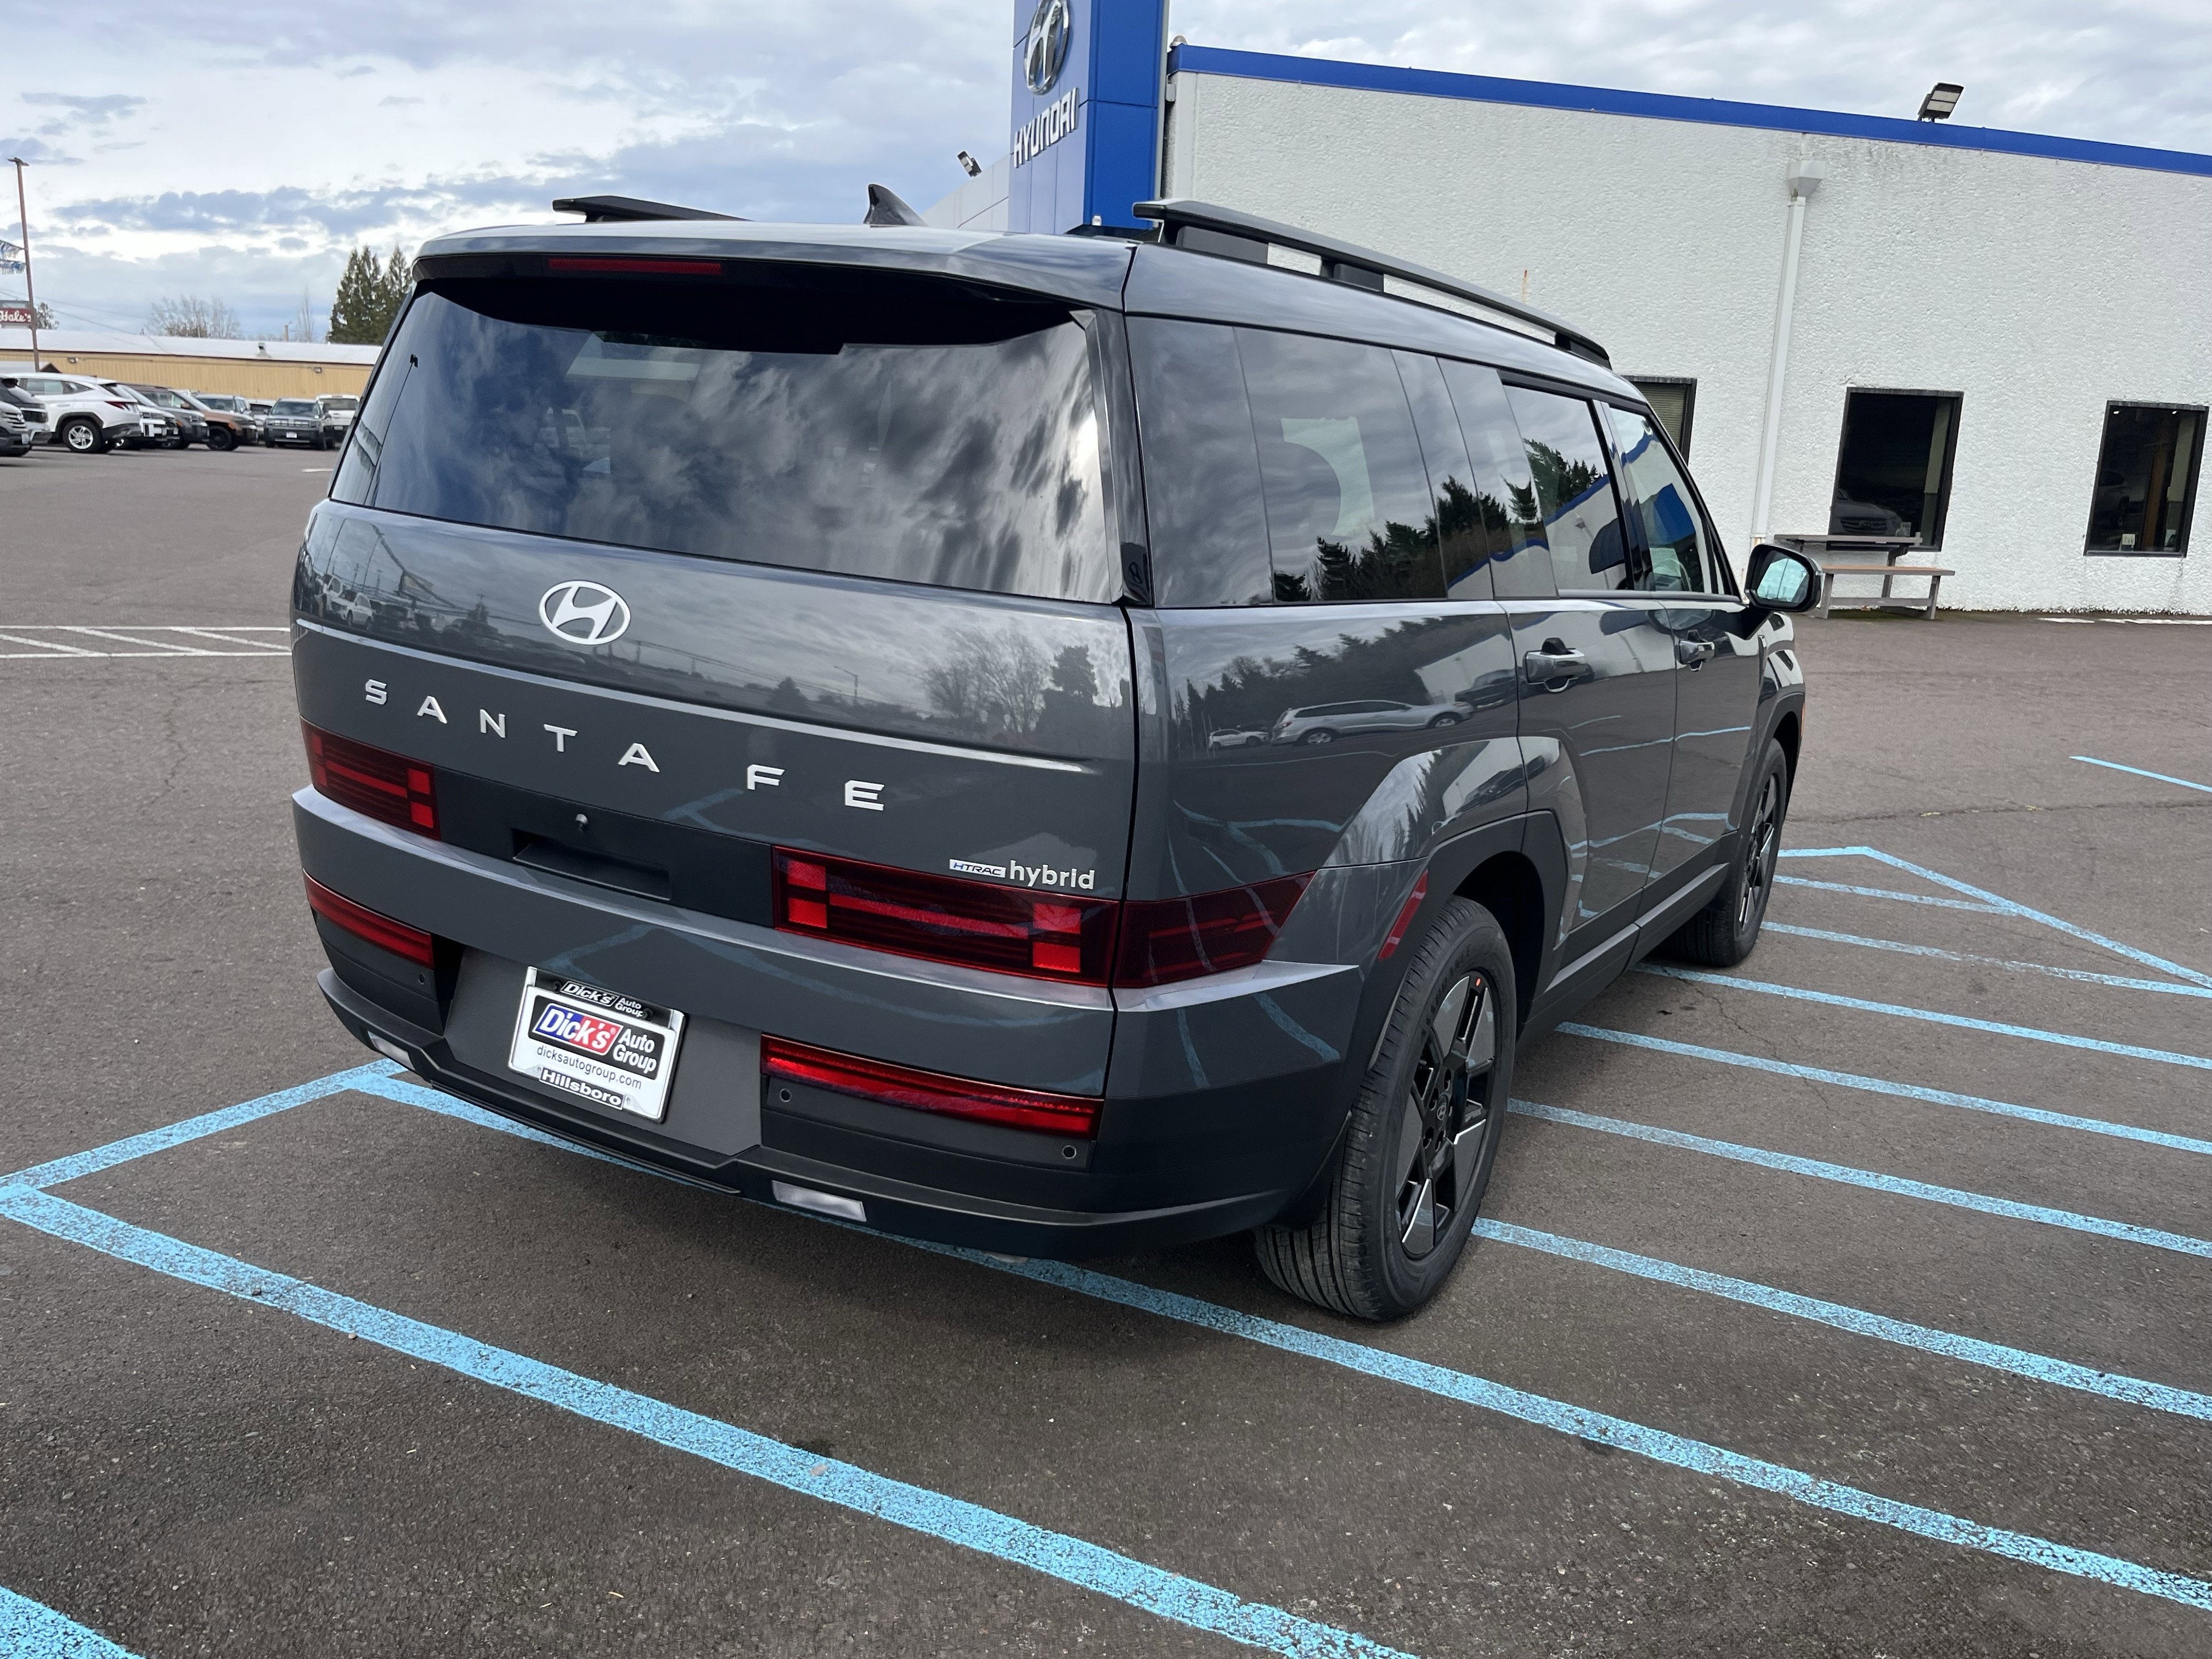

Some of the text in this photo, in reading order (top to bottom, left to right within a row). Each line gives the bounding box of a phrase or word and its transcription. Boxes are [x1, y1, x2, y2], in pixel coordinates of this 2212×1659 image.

[1014, 87, 1079, 168] HYUNDAI
[365, 679, 885, 811] SANTA FE
[953, 860, 1095, 890] HTRAC hybrid
[618, 997, 642, 1009] Auto
[618, 1028, 655, 1053] Auto
[537, 1045, 642, 1090] dicksautogroup.com
[613, 1043, 657, 1074] Group
[541, 1069, 622, 1106] Hillsboro
